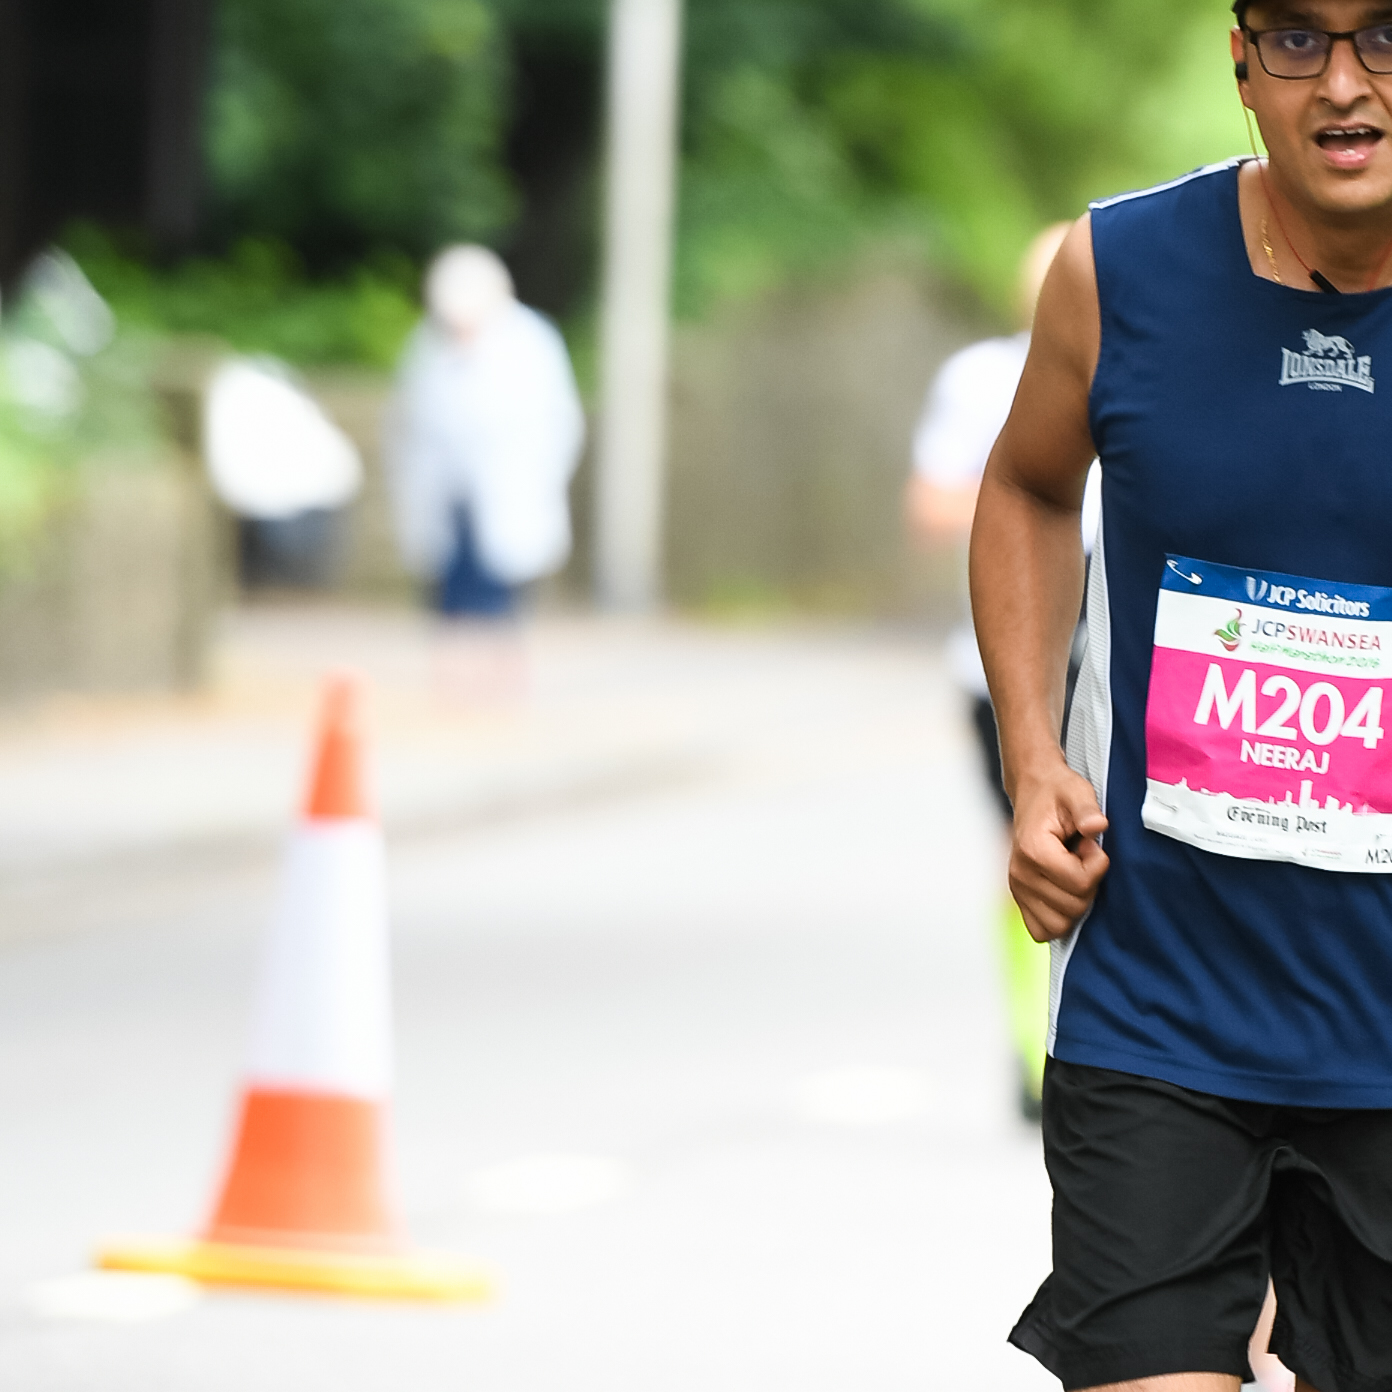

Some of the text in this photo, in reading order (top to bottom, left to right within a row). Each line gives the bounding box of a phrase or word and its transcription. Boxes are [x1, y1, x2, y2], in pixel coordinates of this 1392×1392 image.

[1279, 346, 1375, 393] LONSDALE
[1266, 584, 1370, 618] JCP Solicitors
[1193, 662, 1384, 749] M204
[1240, 739, 1331, 775] NEERAJ
